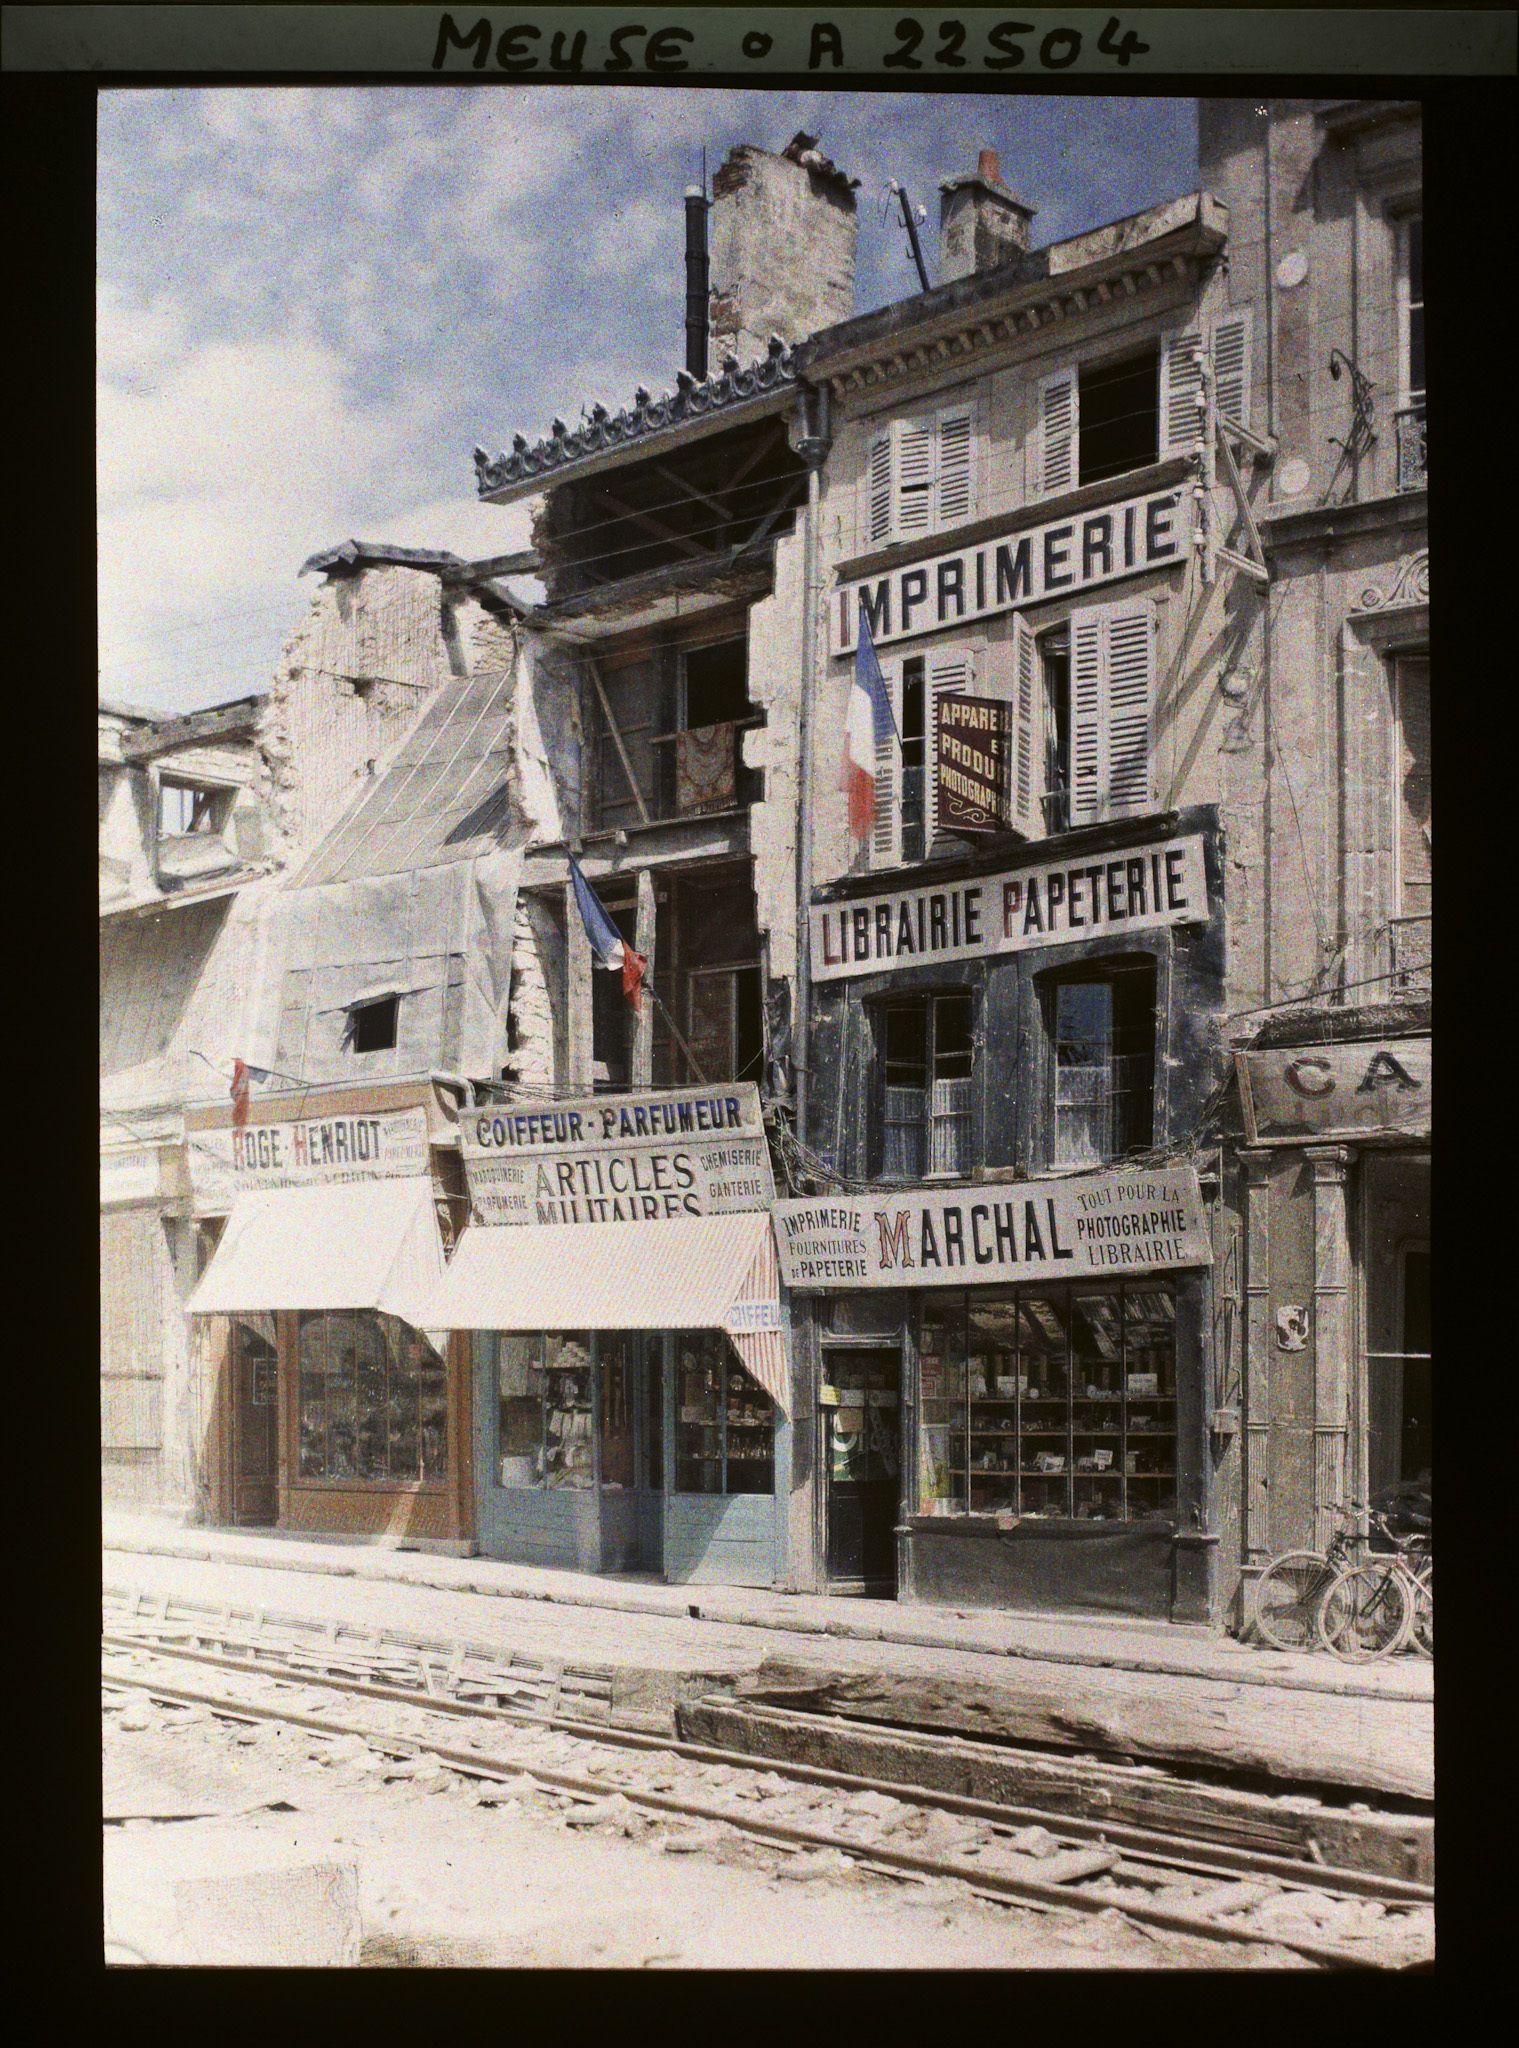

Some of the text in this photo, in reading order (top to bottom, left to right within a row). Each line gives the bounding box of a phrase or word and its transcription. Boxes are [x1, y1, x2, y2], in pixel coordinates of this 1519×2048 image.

[431, 14, 694, 70] MEUSE
[809, 22, 844, 69] A
[884, 17, 1150, 70] 22504
[840, 494, 1180, 648] IMPRIMERIE
[823, 850, 1188, 966] LIBRAIRIE PAPETERIE
[476, 1112, 584, 1148] COIFFEUR
[599, 1097, 743, 1139] PARFUMEUR
[293, 1120, 381, 1167] HENRIOT
[536, 1153, 697, 1198] ARTICLES
[700, 1150, 762, 1171] CHEMISERIE
[710, 1180, 762, 1198] GANTERIE
[1077, 1184, 1180, 1212] TOUT POUR LA
[782, 1209, 861, 1237] IMPRIMERIE
[874, 1198, 1073, 1269] MARCHAL
[1077, 1209, 1186, 1240] PHOTOGRAPHIE
[789, 1240, 866, 1256] FOURNITURES
[1088, 1238, 1186, 1266] LIBRAIRIE
[800, 1260, 868, 1278] PAPETERIE
